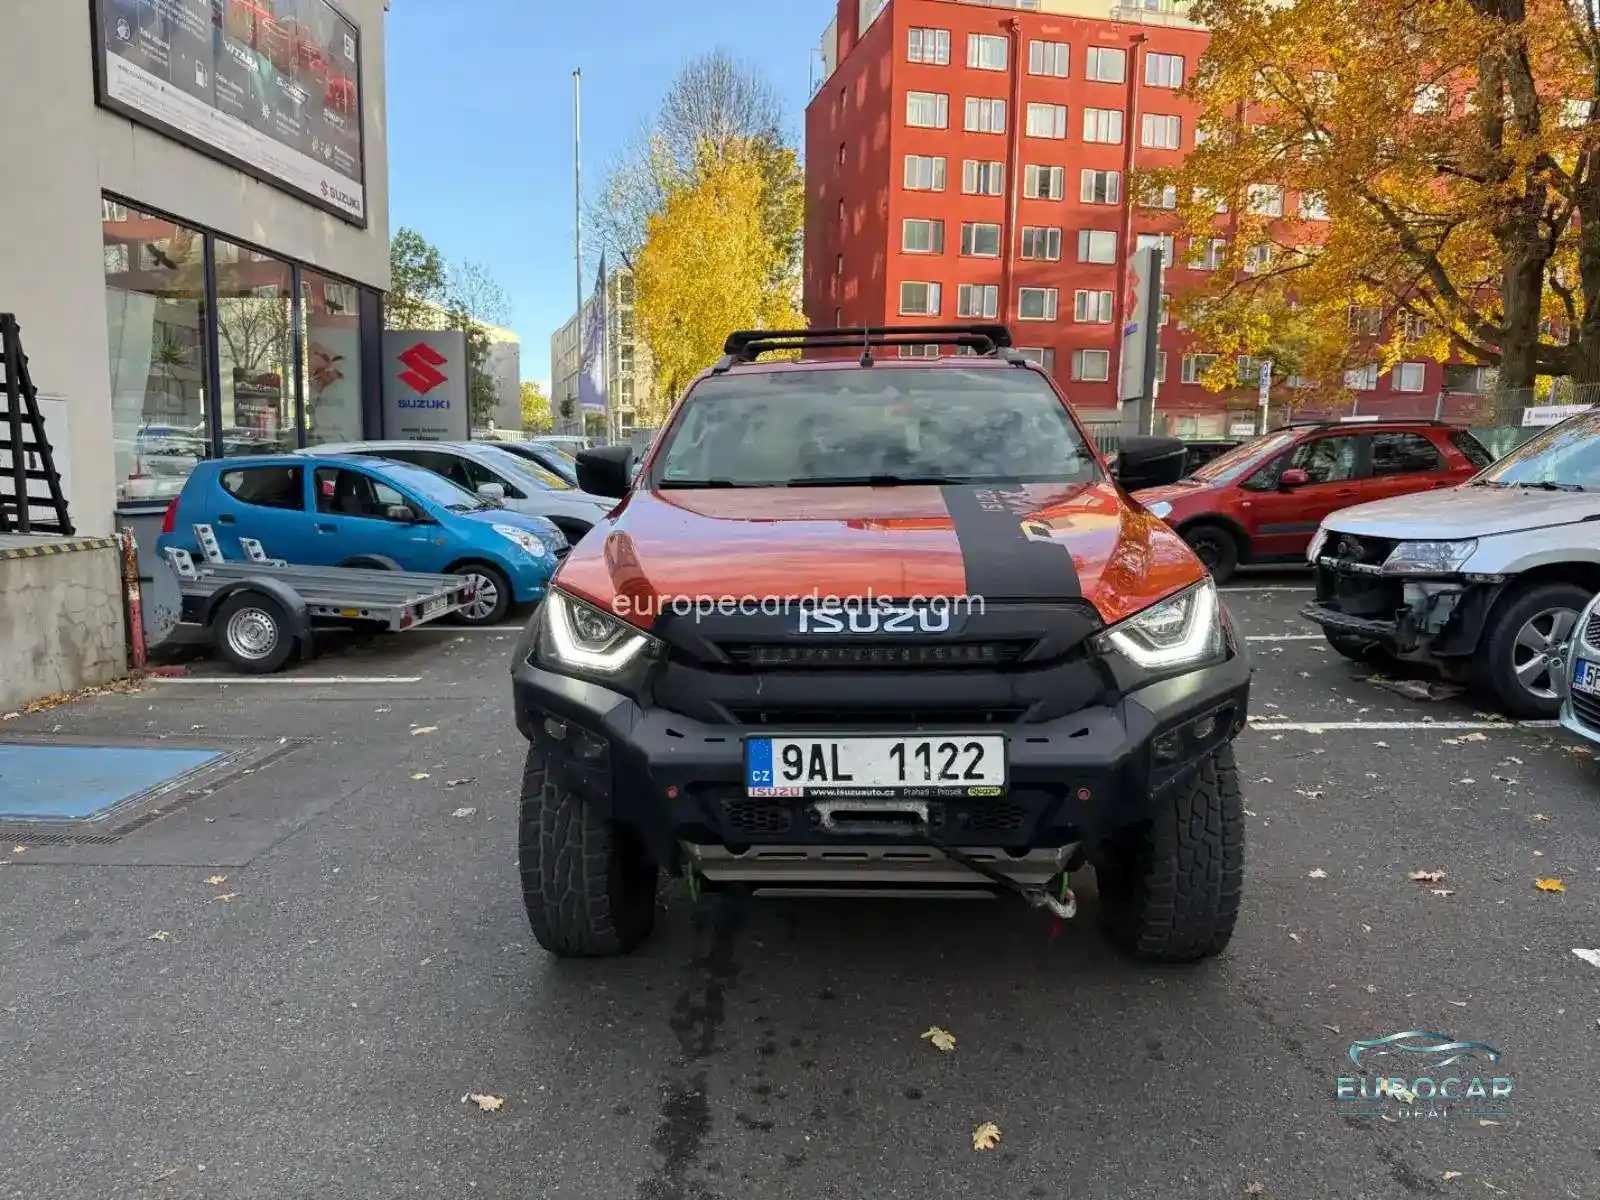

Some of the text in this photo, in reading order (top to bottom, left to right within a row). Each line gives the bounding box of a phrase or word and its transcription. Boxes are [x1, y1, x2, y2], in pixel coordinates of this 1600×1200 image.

[224, 41, 260, 71] VITARA
[330, 186, 361, 211] SUZUKI
[398, 399, 450, 409] SUZUKI
[799, 607, 950, 633] ISUZU
[752, 742, 985, 782] CZ 9AL 1122
[752, 787, 800, 796] ISUZU
[810, 788, 896, 797] www.isuzuauto.cz
